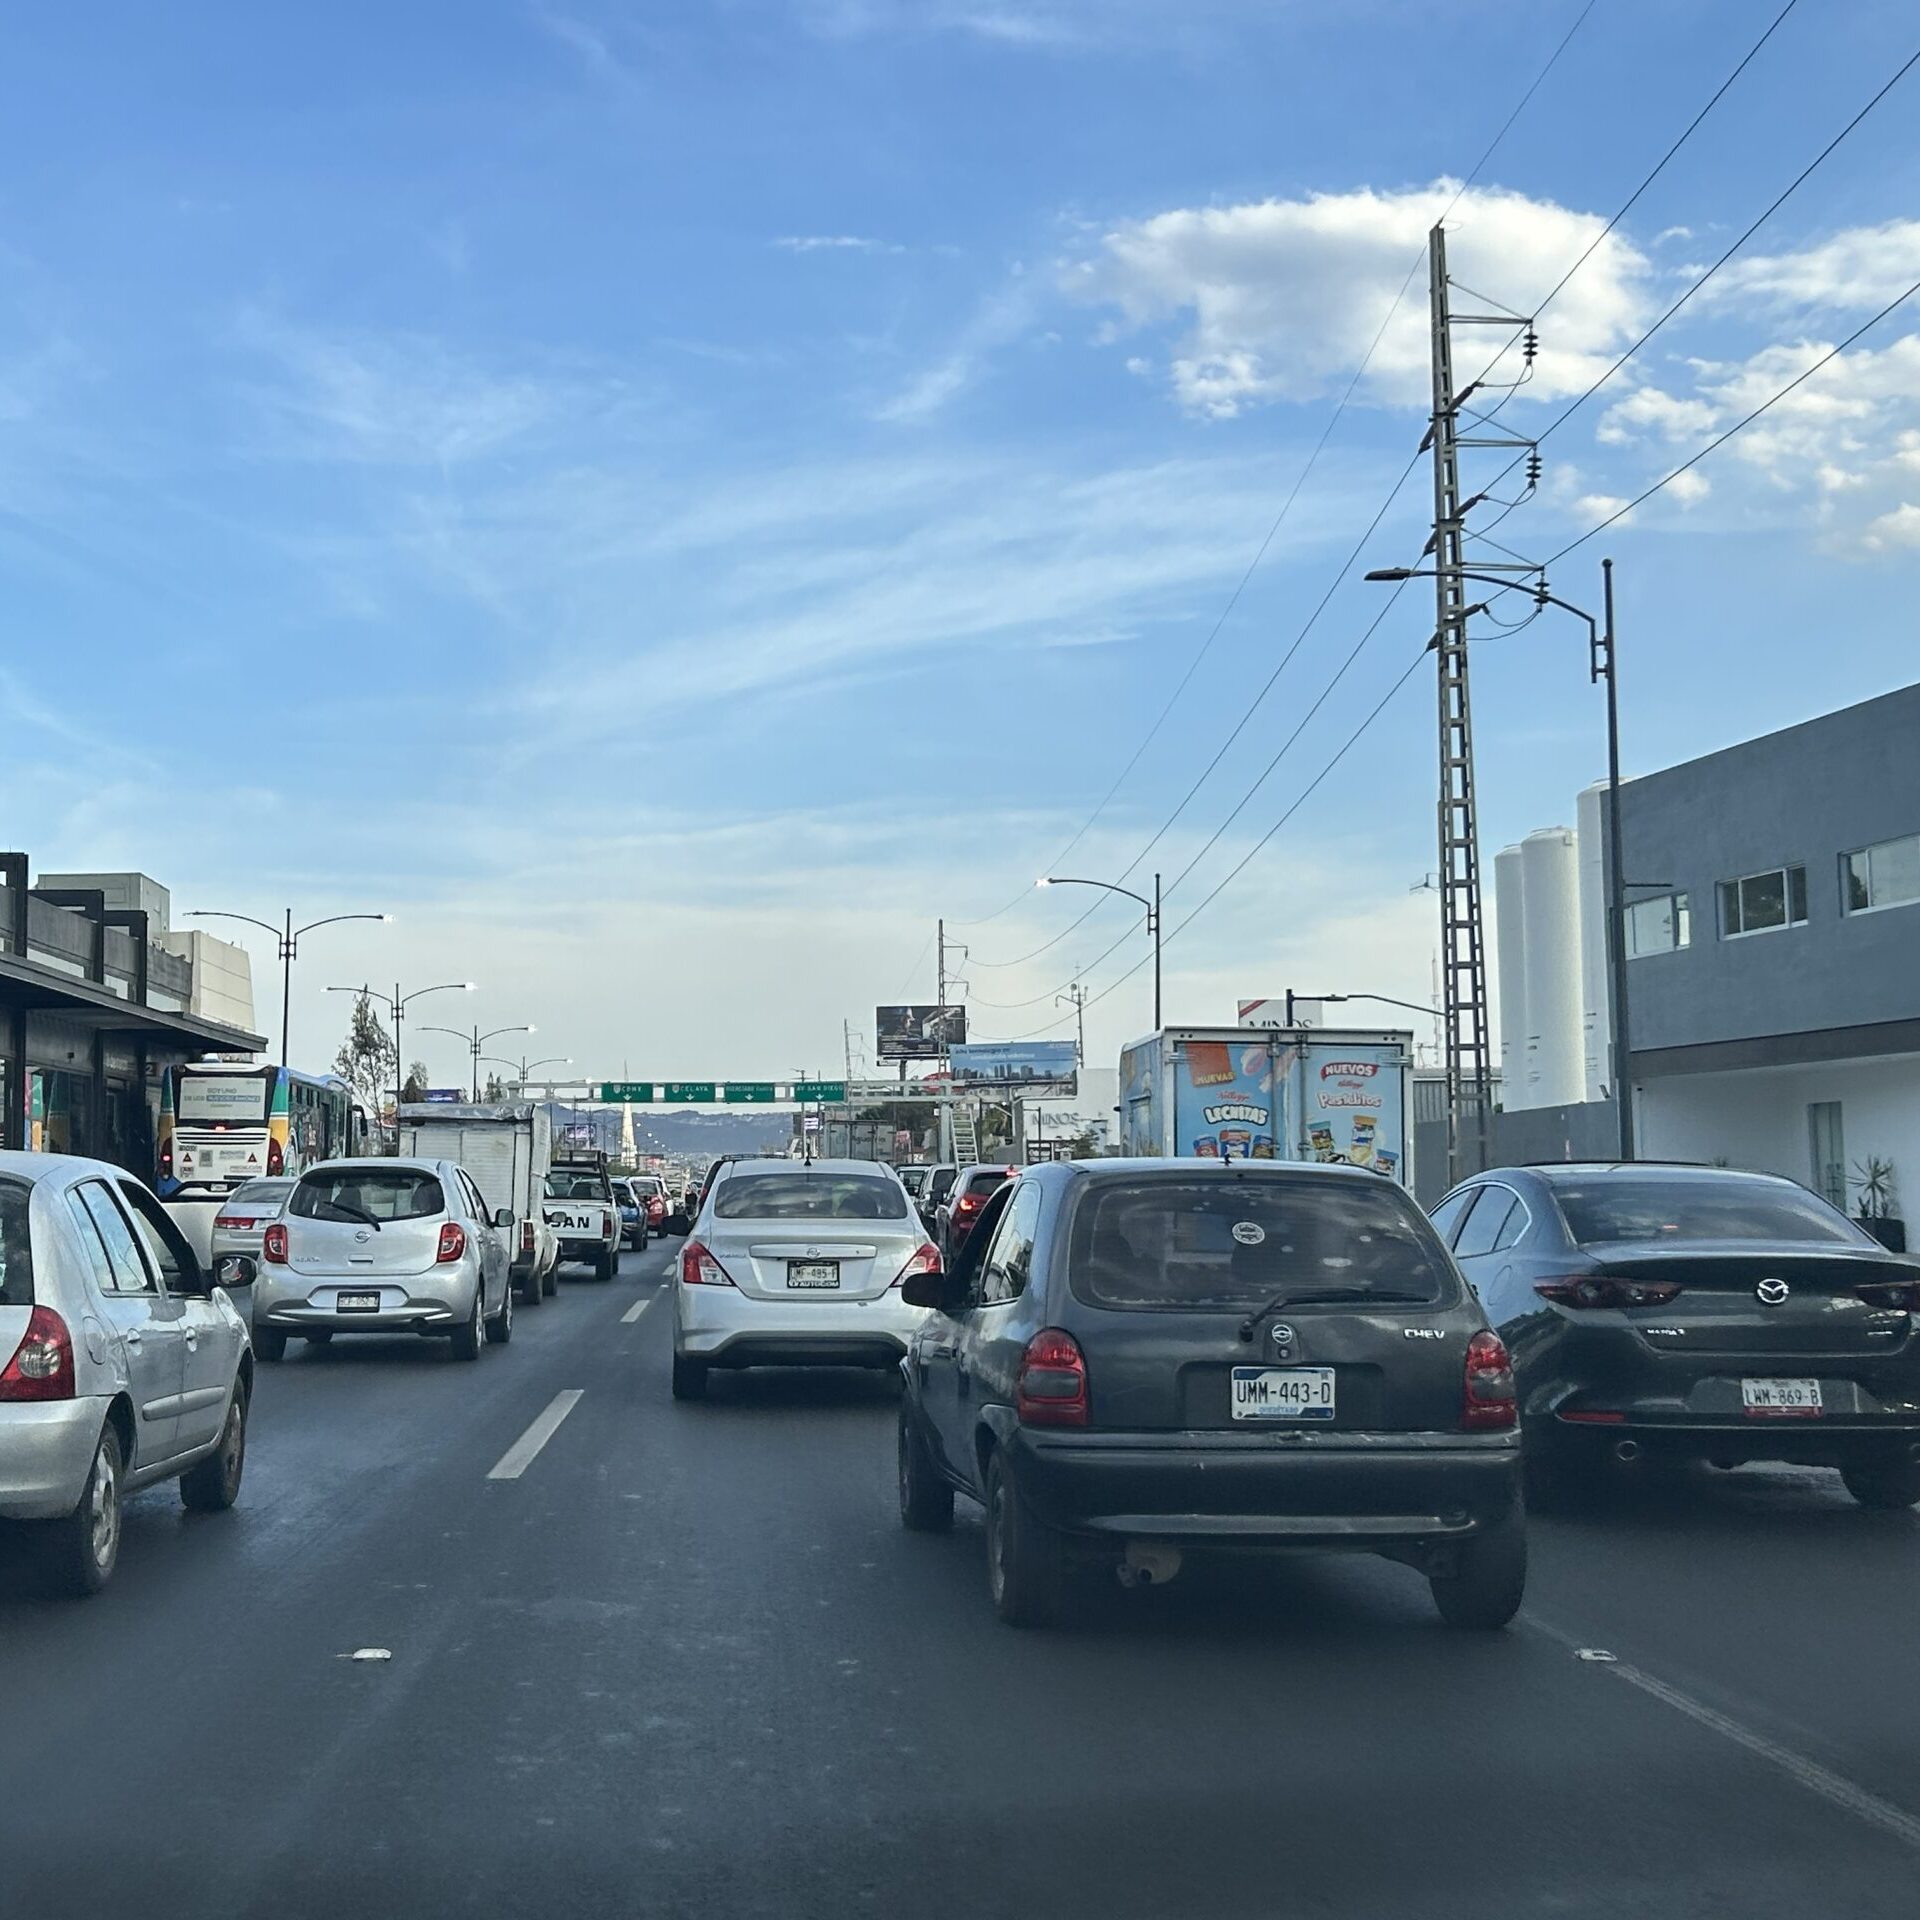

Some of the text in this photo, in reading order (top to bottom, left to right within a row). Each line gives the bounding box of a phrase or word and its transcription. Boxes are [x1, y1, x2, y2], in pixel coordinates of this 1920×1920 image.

[1325, 1064, 1374, 1076] NUEVOS
[1195, 1071, 1234, 1086] NUEVAS
[1204, 1105, 1269, 1125] LECHITAS
[1404, 1328, 1446, 1339] CHEV
[1236, 1381, 1331, 1403] UMM-443-D
